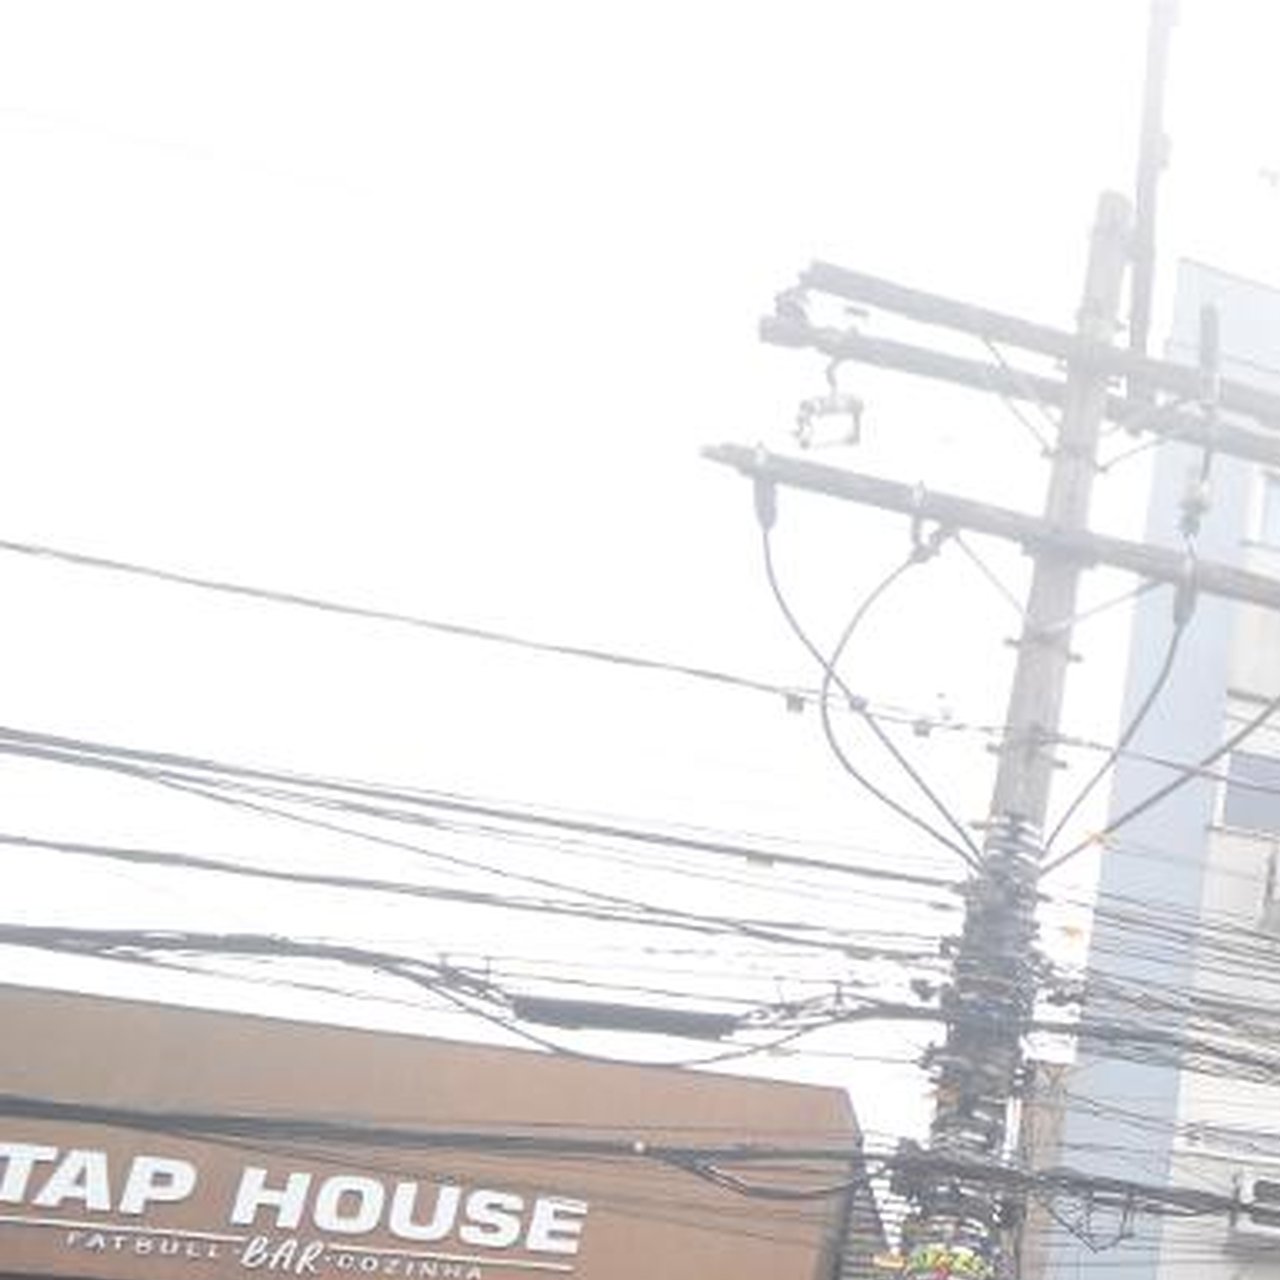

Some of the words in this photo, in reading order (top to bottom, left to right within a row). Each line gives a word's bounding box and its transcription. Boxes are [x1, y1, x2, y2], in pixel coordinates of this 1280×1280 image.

[0, 1142, 197, 1214] TAP
[231, 1166, 588, 1254] HOUSE
[240, 1236, 325, 1275] BAR
[337, 1256, 482, 1280] COZINHA
